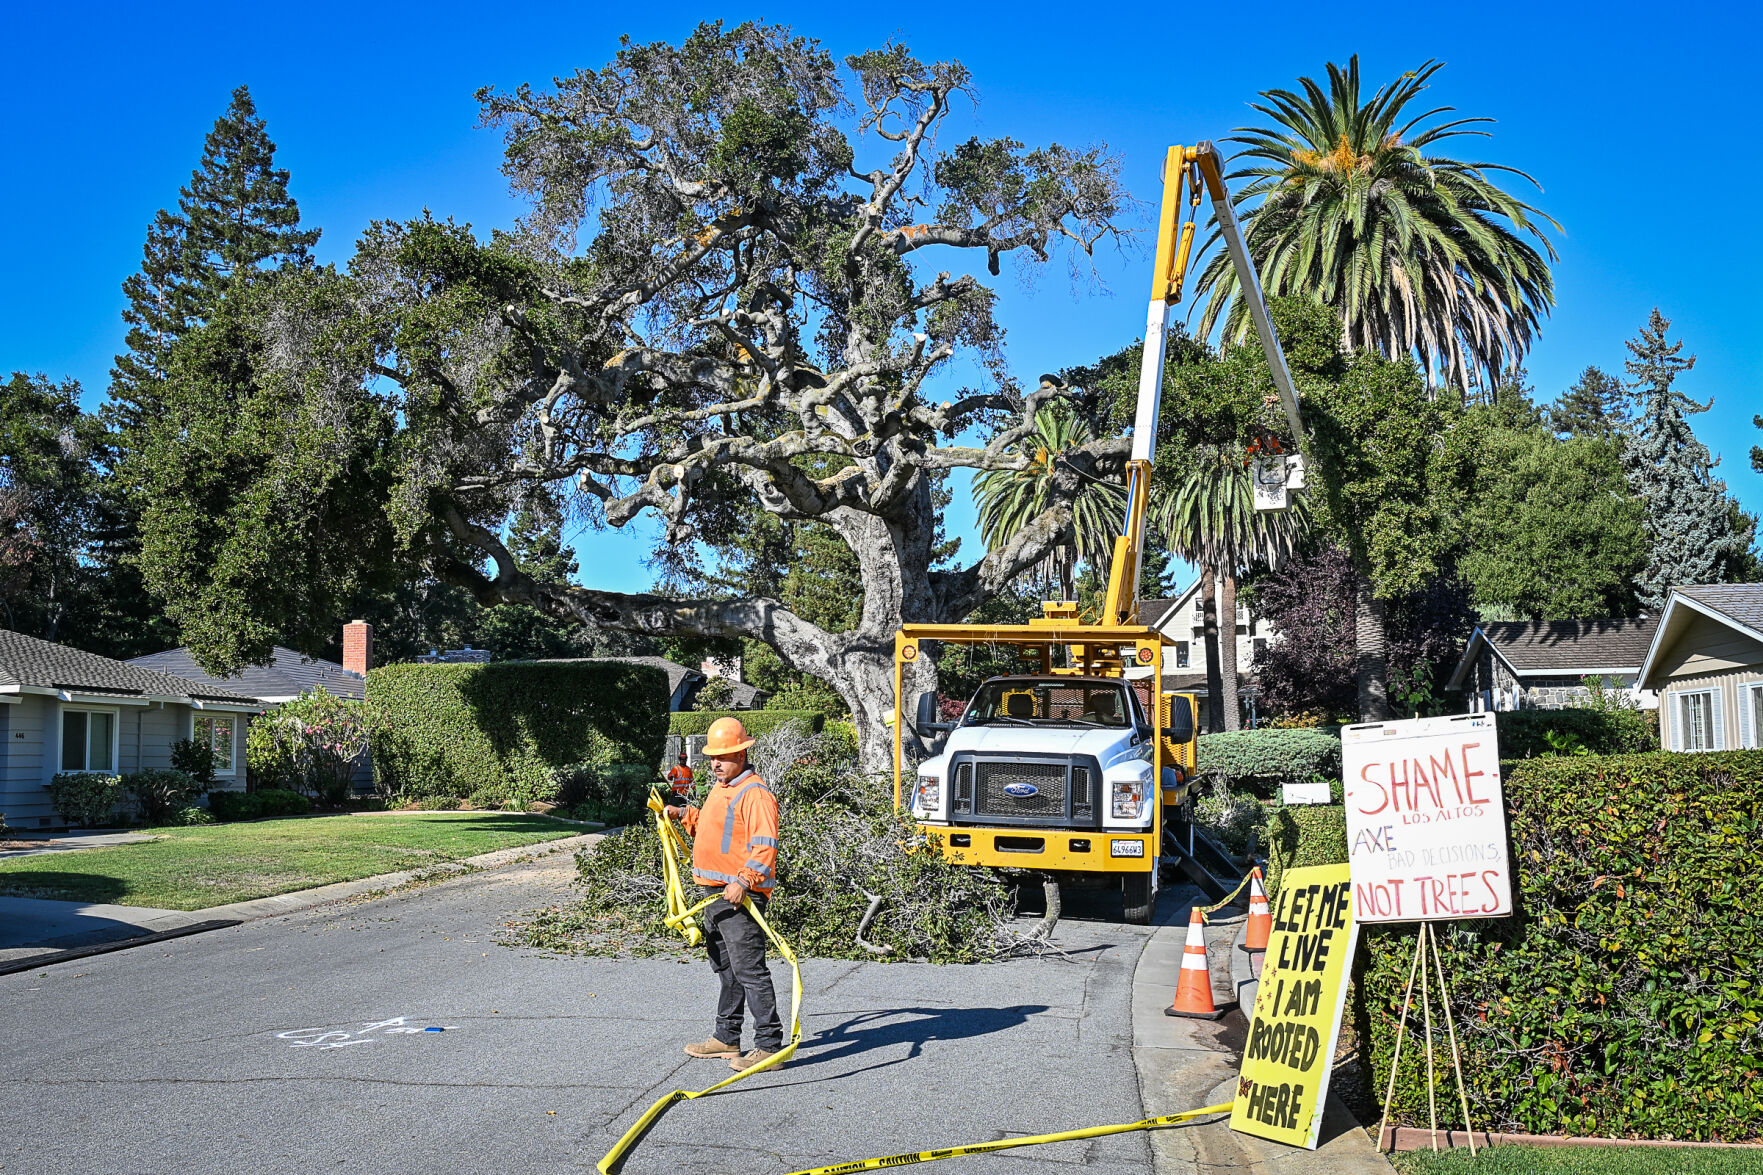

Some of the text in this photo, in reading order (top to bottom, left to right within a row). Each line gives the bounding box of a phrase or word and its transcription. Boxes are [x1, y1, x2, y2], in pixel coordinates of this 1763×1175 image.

[1359, 742, 1490, 815] SHAME
[1402, 805, 1485, 825] LOS ALTOS
[1352, 825, 1397, 856] AXE
[1387, 849, 1415, 870] BAD
[1274, 881, 1351, 932] LET ME
[1357, 869, 1500, 917] NOT TREES
[1278, 929, 1334, 972] LIVE
[1272, 978, 1322, 1017] I AM
[1248, 1016, 1320, 1072] ROOTED
[1247, 1082, 1304, 1130] HERE
[878, 1152, 920, 1166] CAUTION
